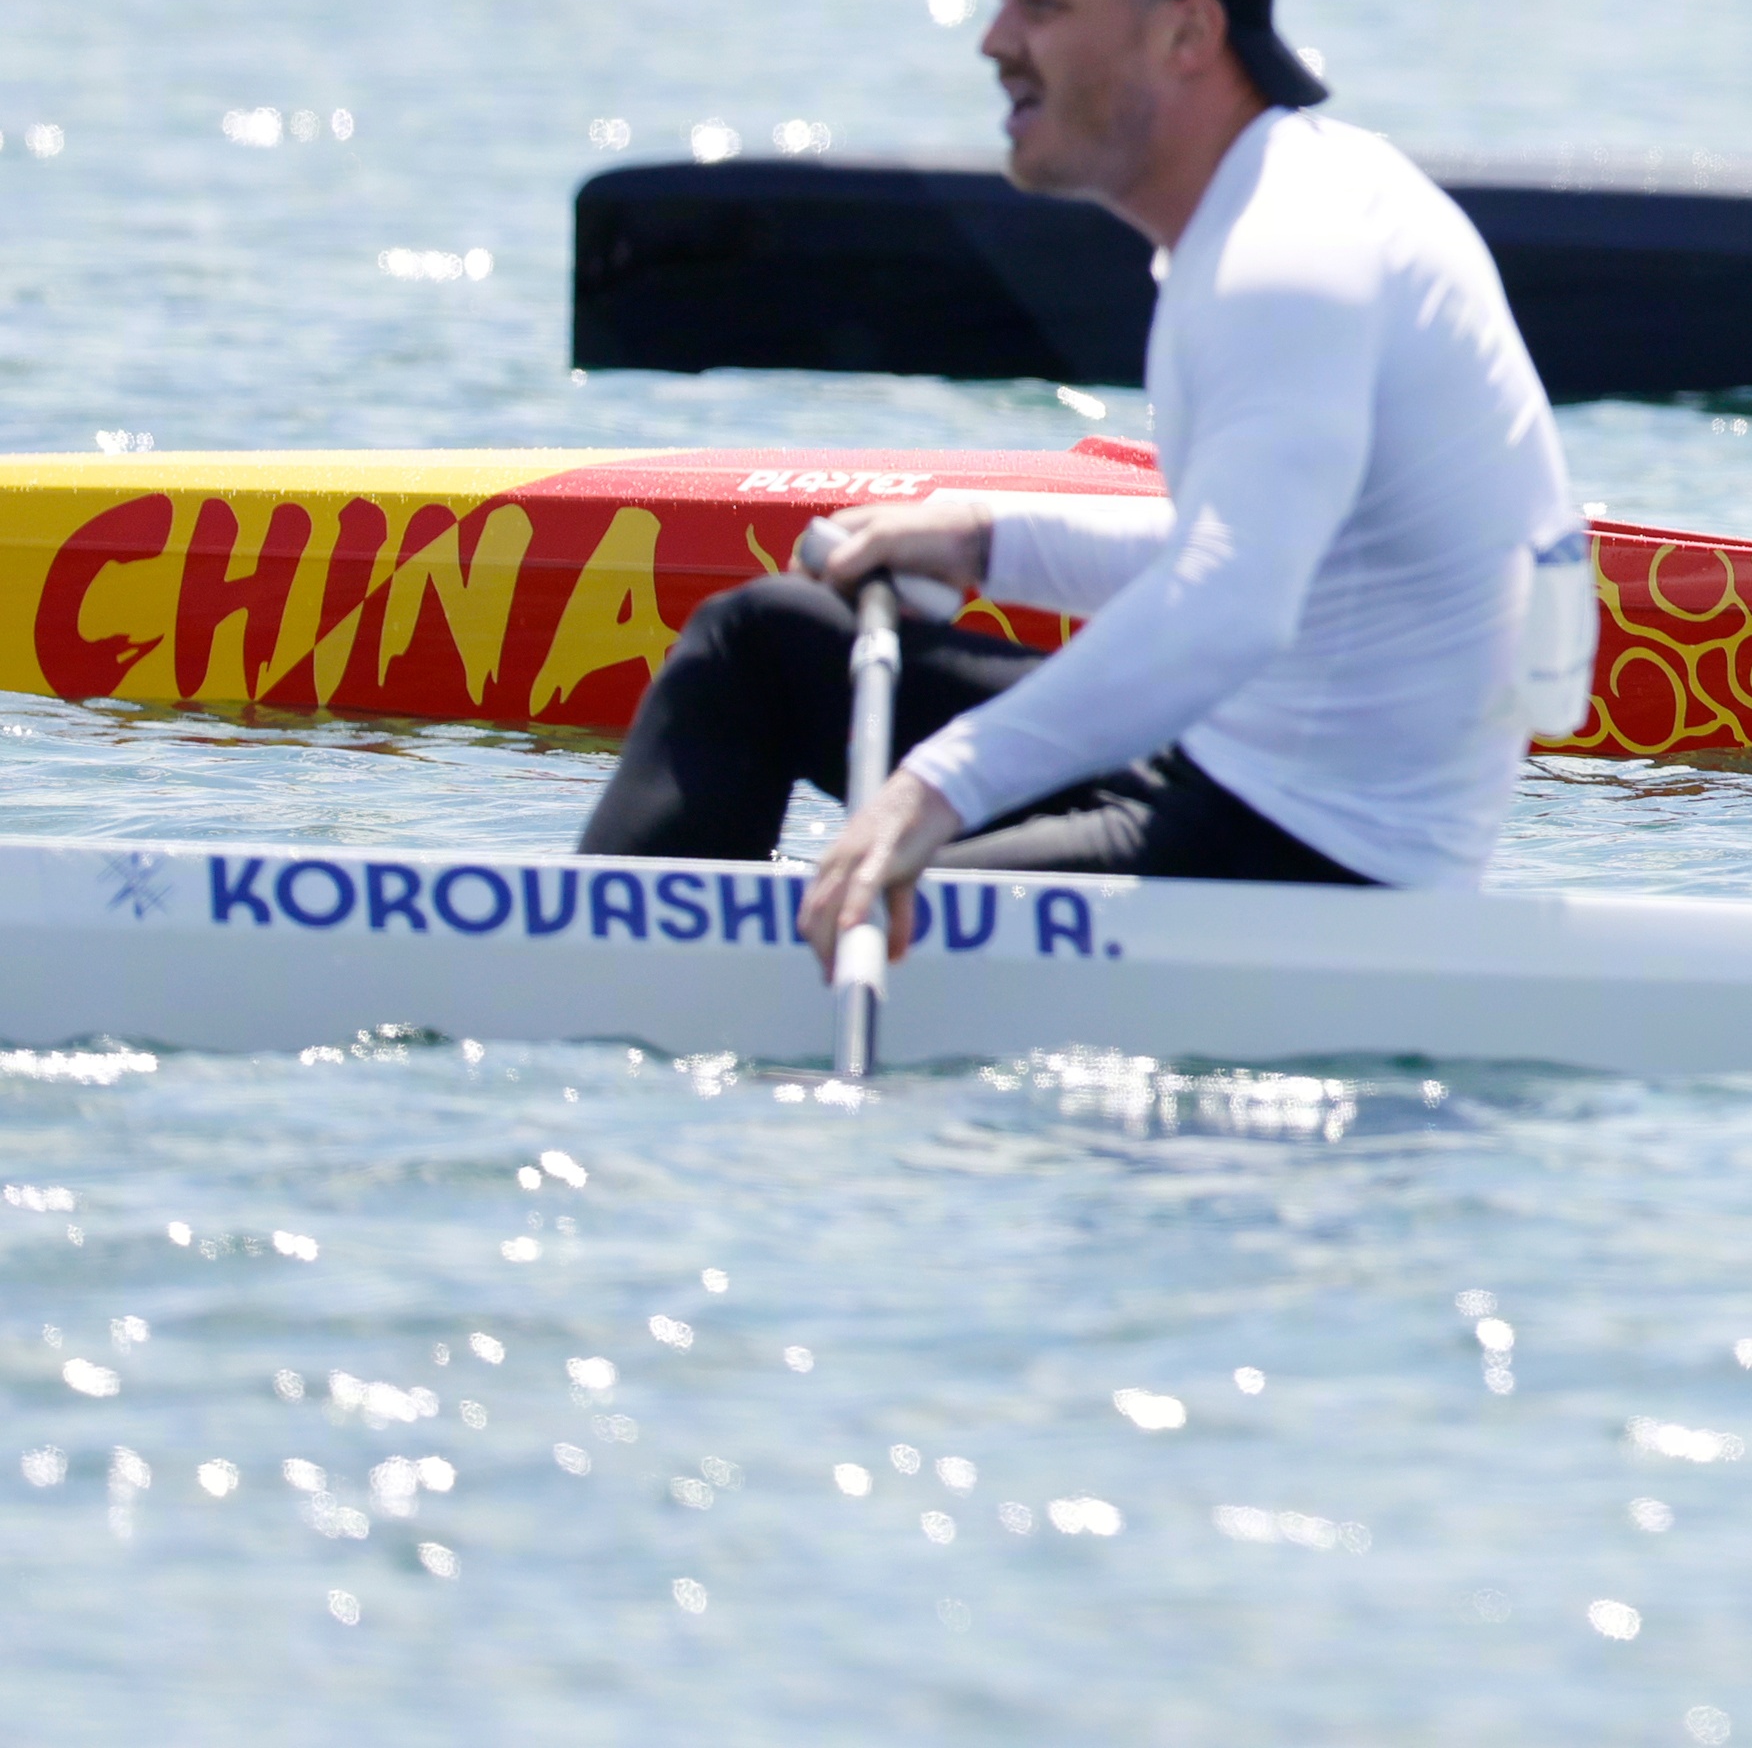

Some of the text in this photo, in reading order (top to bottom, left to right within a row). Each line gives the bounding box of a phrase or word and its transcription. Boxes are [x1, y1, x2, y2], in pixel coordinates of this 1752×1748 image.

[34, 493, 682, 717] CHINA
[209, 855, 1124, 959] KOROVASHV A.
